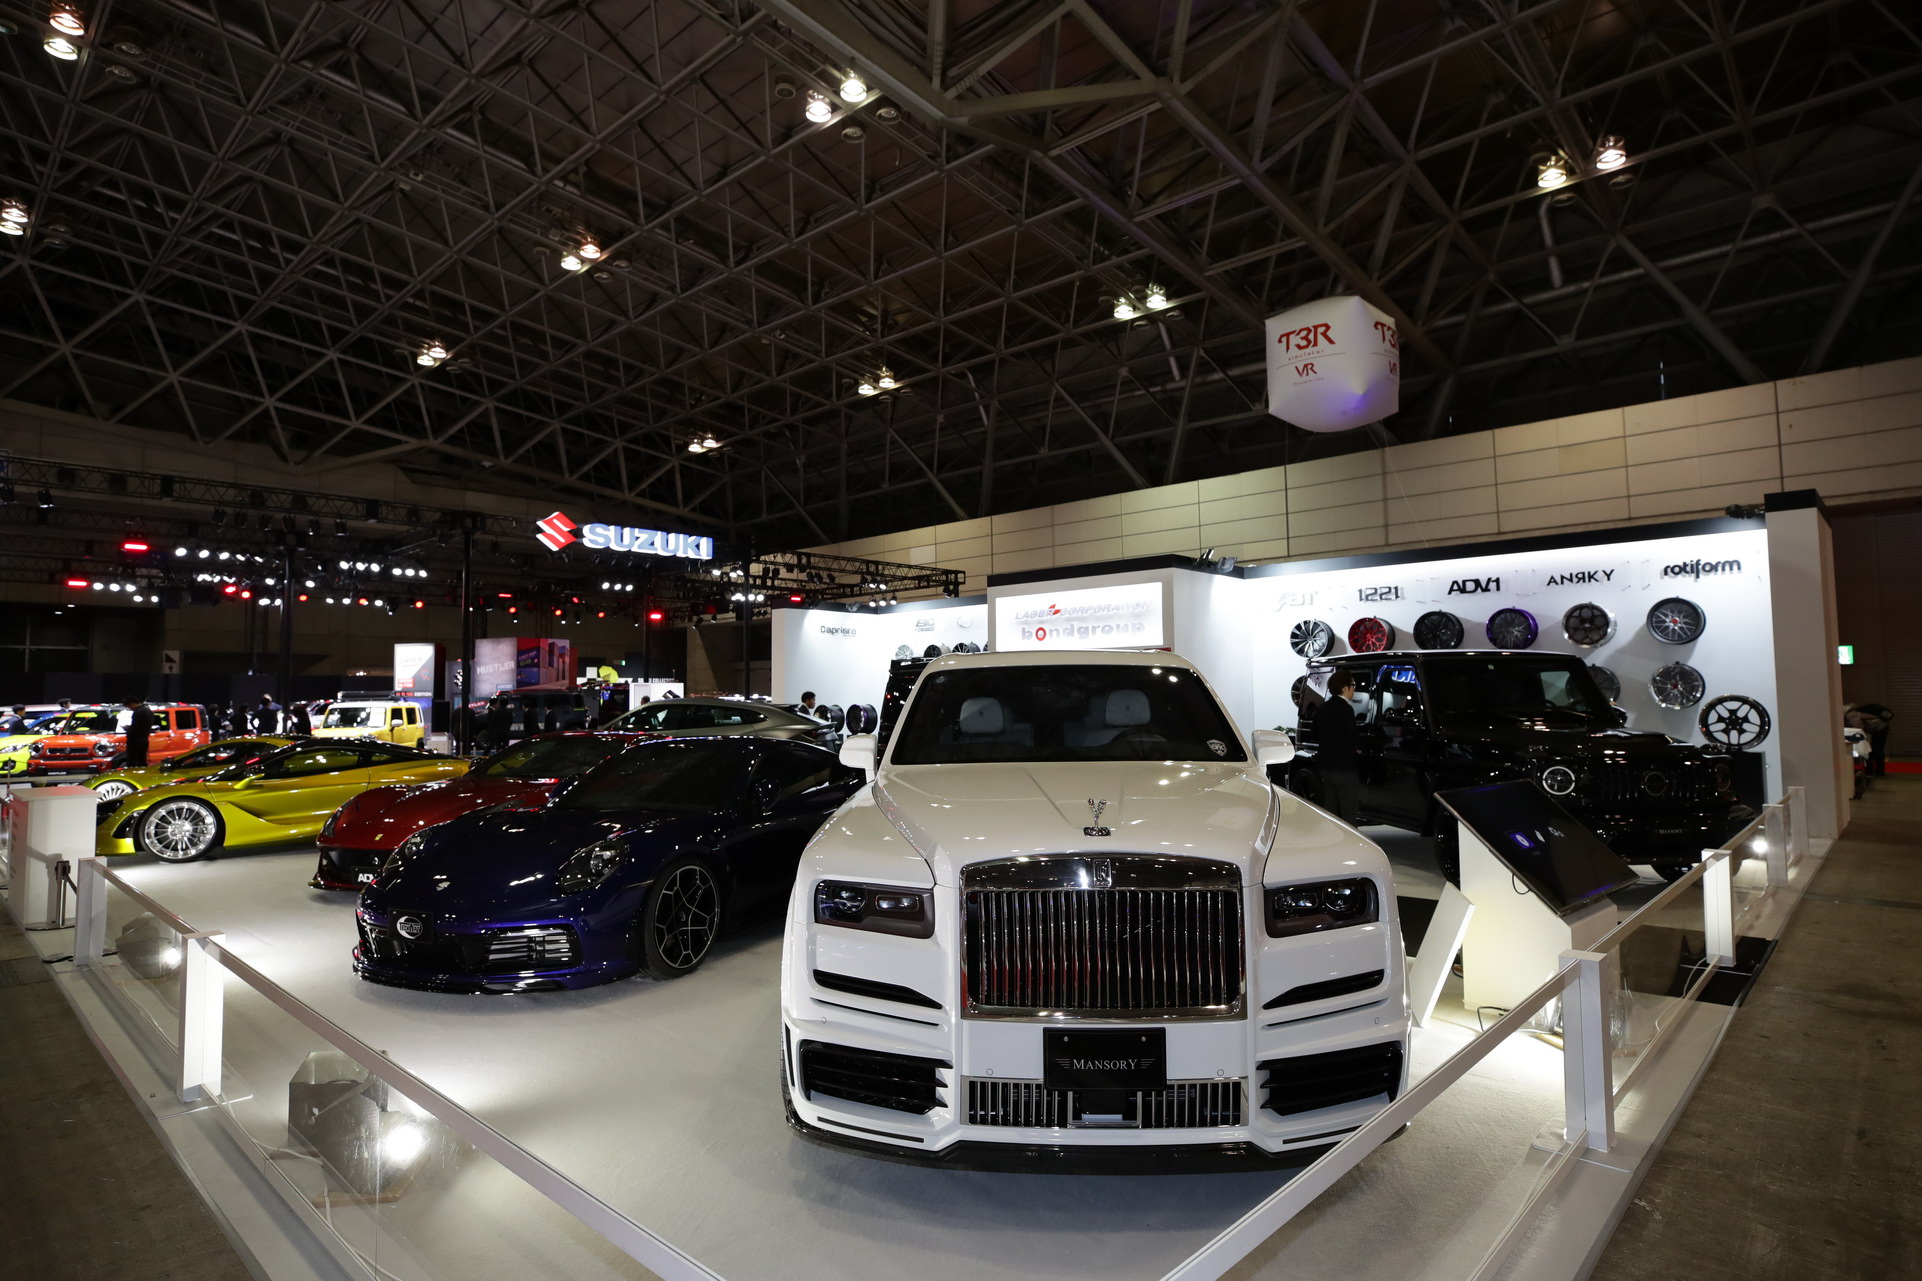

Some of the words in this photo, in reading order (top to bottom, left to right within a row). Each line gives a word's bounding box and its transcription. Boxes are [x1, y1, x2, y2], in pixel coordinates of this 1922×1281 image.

[1277, 322, 1336, 354] T3R
[1294, 362, 1318, 377] VR
[582, 523, 713, 560] SUZUKI
[1663, 559, 1742, 579] rotiform
[1357, 585, 1401, 603] 1221
[1059, 600, 1152, 617] CORPORATION
[1021, 622, 1146, 641] bondgroup
[477, 661, 515, 675] HUSTLER
[1073, 1058, 1138, 1070] MANSORY
